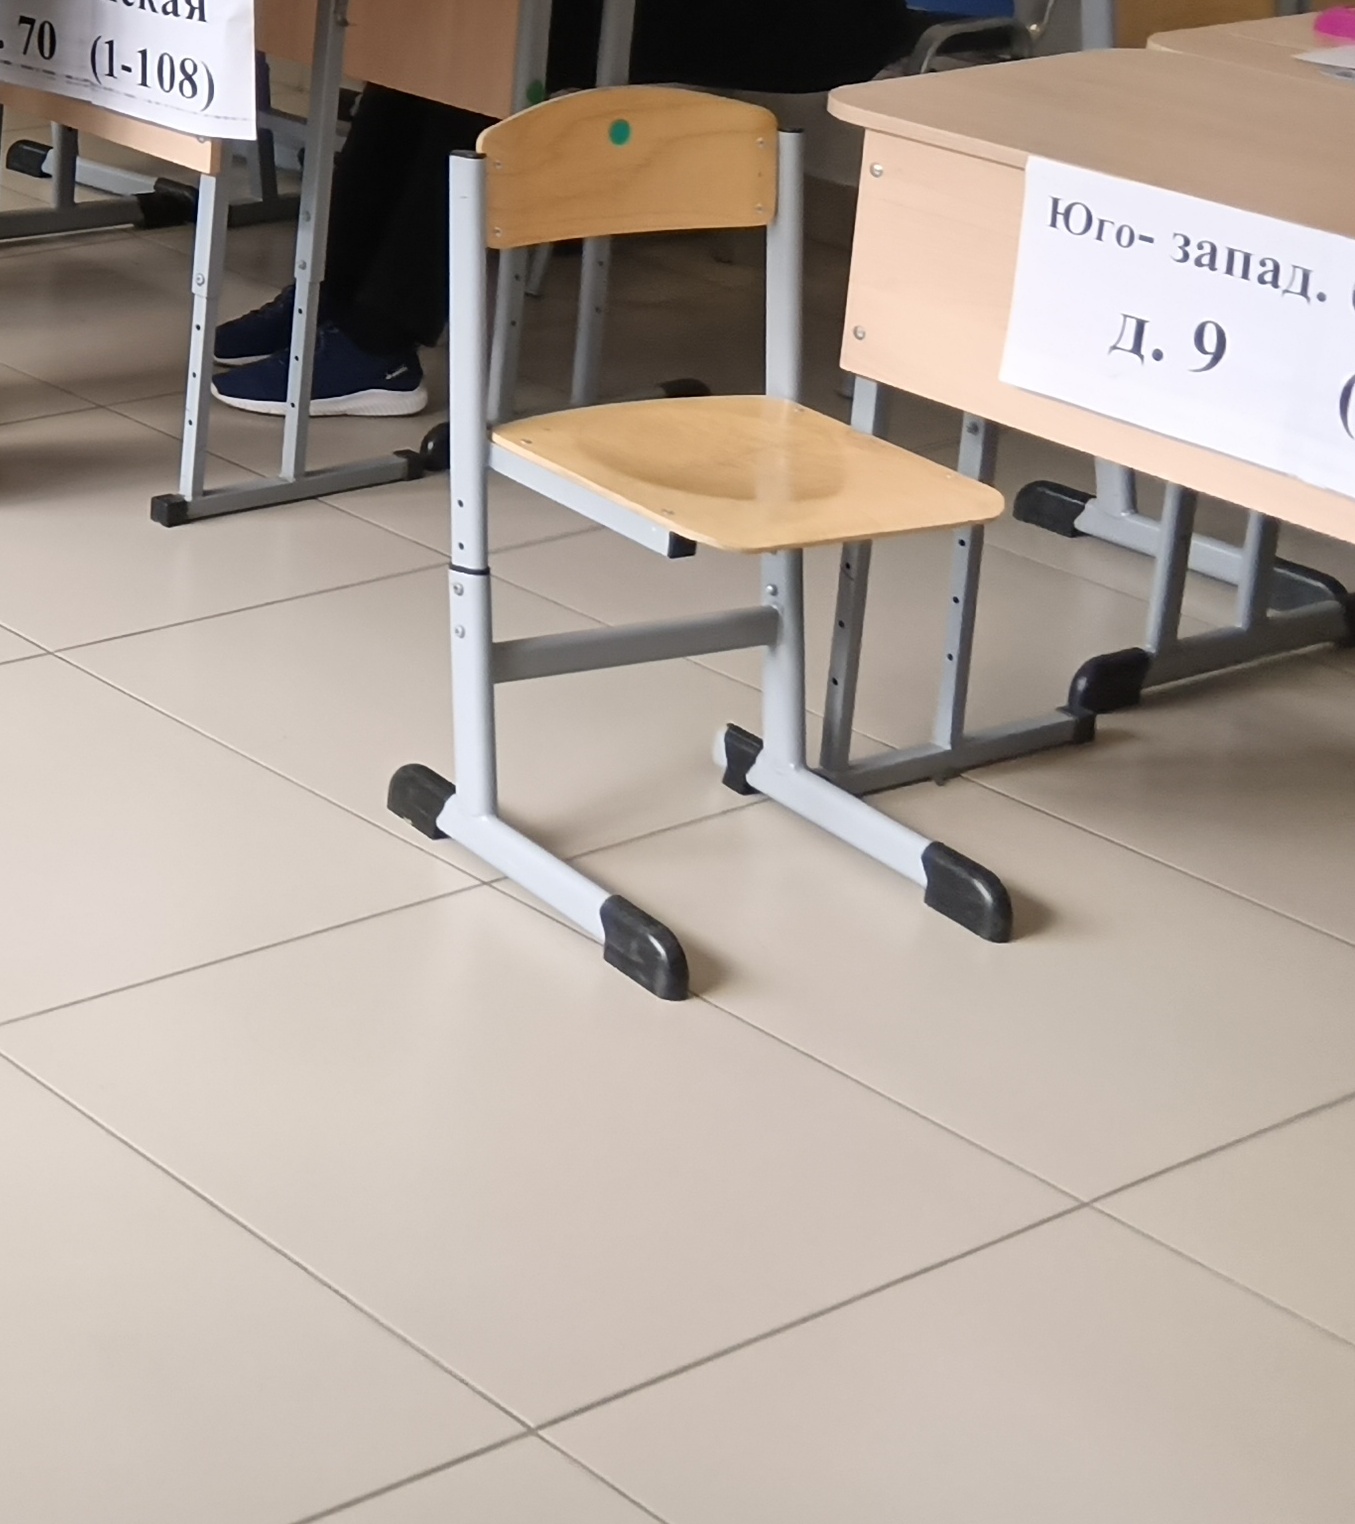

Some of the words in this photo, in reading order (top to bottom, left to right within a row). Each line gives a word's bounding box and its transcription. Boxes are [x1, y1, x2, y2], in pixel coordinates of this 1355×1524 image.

[18, 15, 56, 60] 70
[90, 35, 215, 112] (1-108)
[1048, 195, 1155, 249] Юго-
[1169, 232, 1328, 305] запад.
[1108, 313, 1164, 366] д.
[1188, 320, 1227, 373] 9
